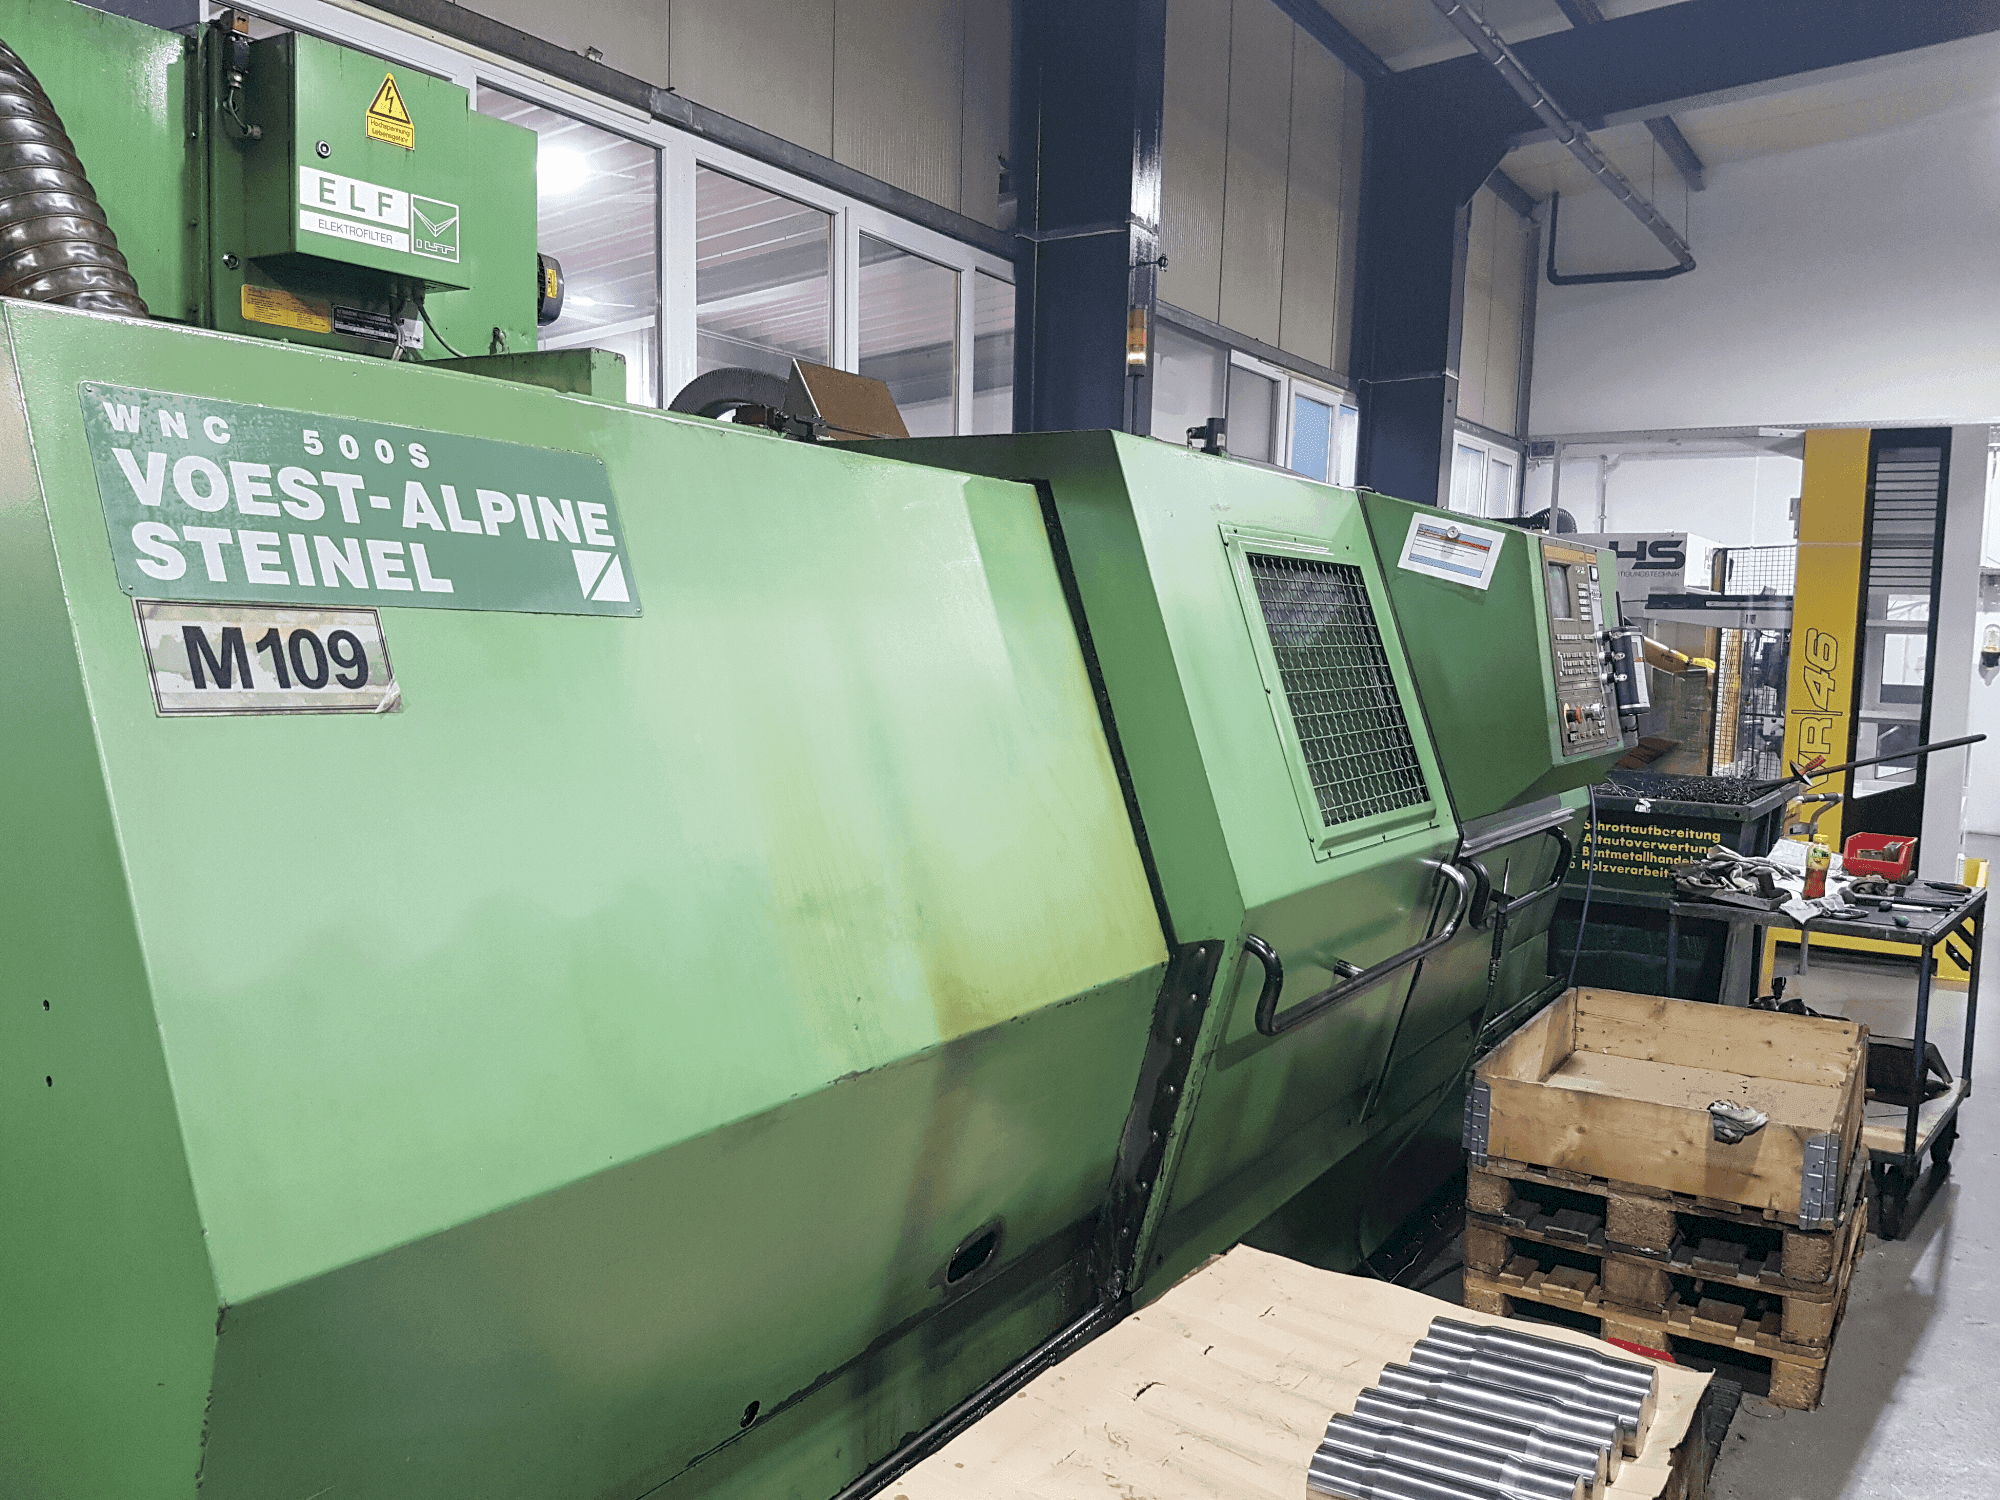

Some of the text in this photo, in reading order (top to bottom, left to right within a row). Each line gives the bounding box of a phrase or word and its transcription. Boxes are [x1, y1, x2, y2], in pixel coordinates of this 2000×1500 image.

[319, 176, 394, 217] ELF
[318, 218, 393, 245] ELEKTROFILTER
[302, 429, 431, 469] 500S
[110, 445, 617, 549] VOEST-ALPINE
[129, 521, 454, 595] STEINEL
[1618, 570, 1680, 579] TIGUNGSTECHNIK
[1583, 820, 1721, 844] Shrottaufbereitung
[1583, 833, 1715, 854] Atautoverwertun
[1582, 845, 1694, 865] Bntmetallhandel
[1581, 859, 1669, 878] Holzverarbeit
